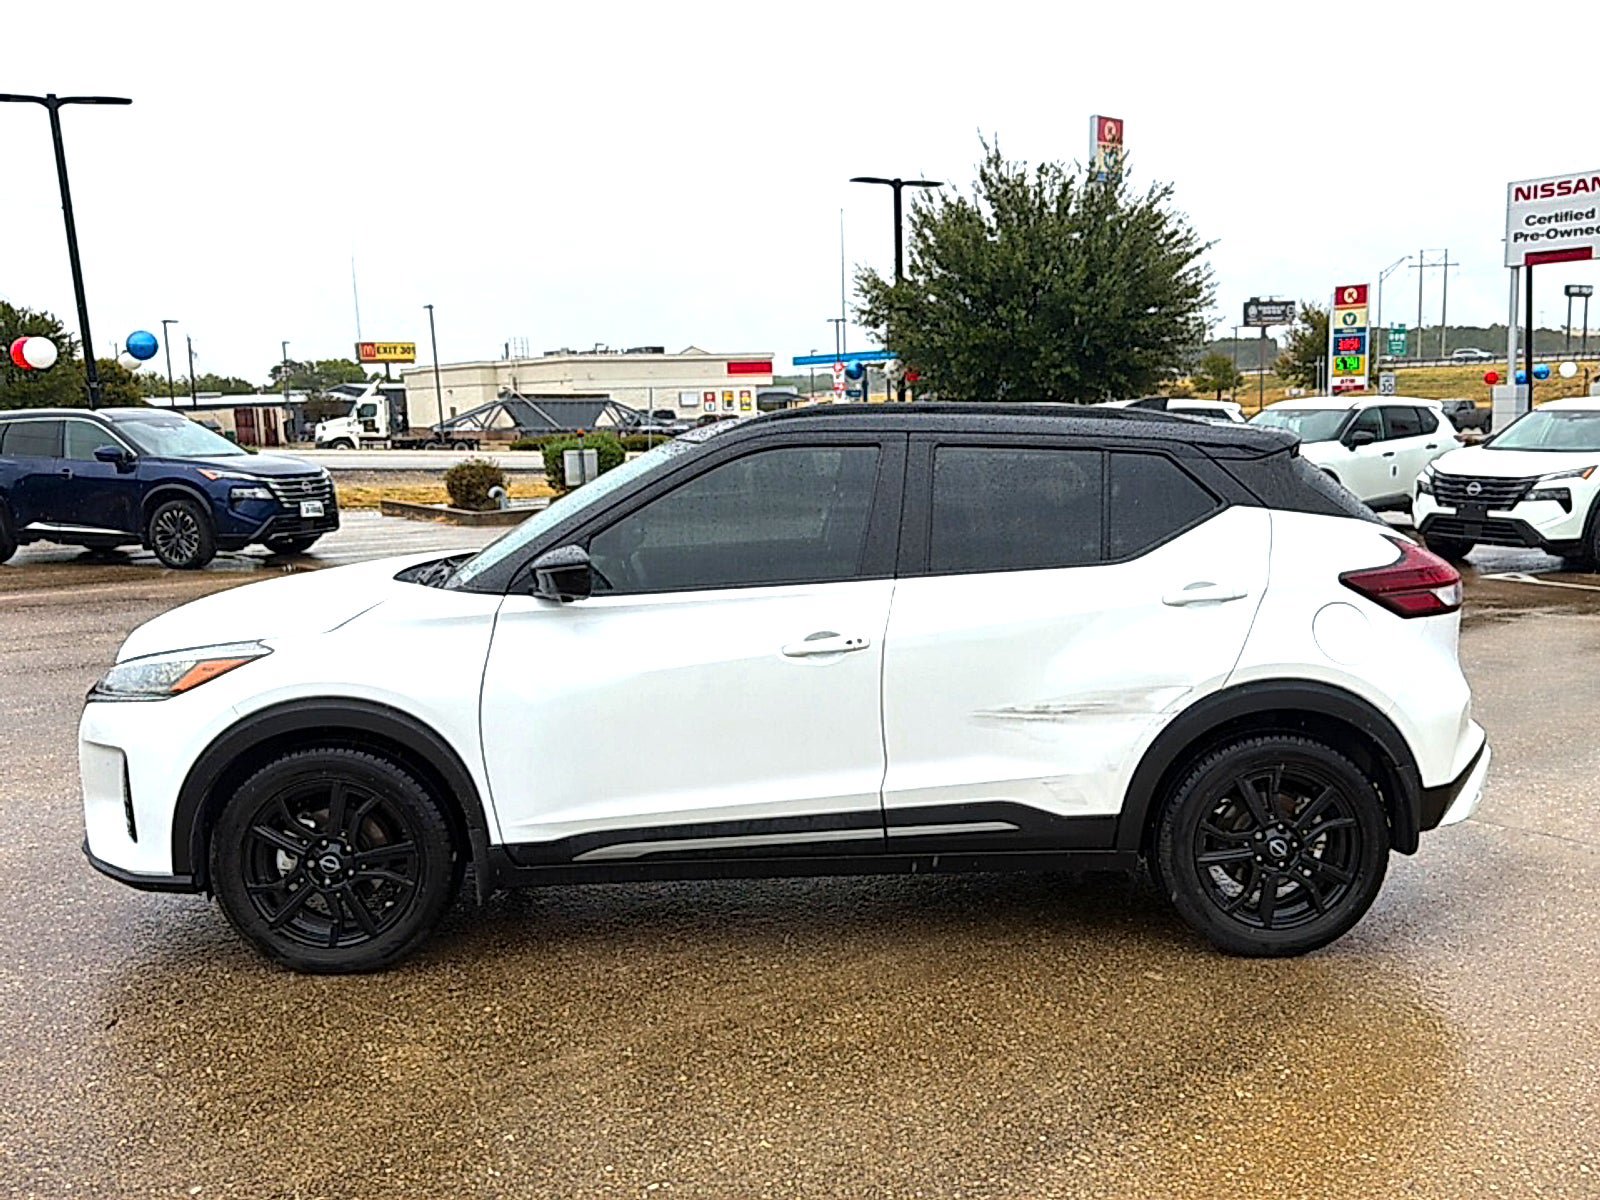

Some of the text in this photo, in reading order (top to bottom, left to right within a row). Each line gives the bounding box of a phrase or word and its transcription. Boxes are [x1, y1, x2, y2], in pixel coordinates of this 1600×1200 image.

[1525, 207, 1596, 226] Certified
[377, 346, 397, 355] EXIT
[1382, 383, 1394, 393] 30
